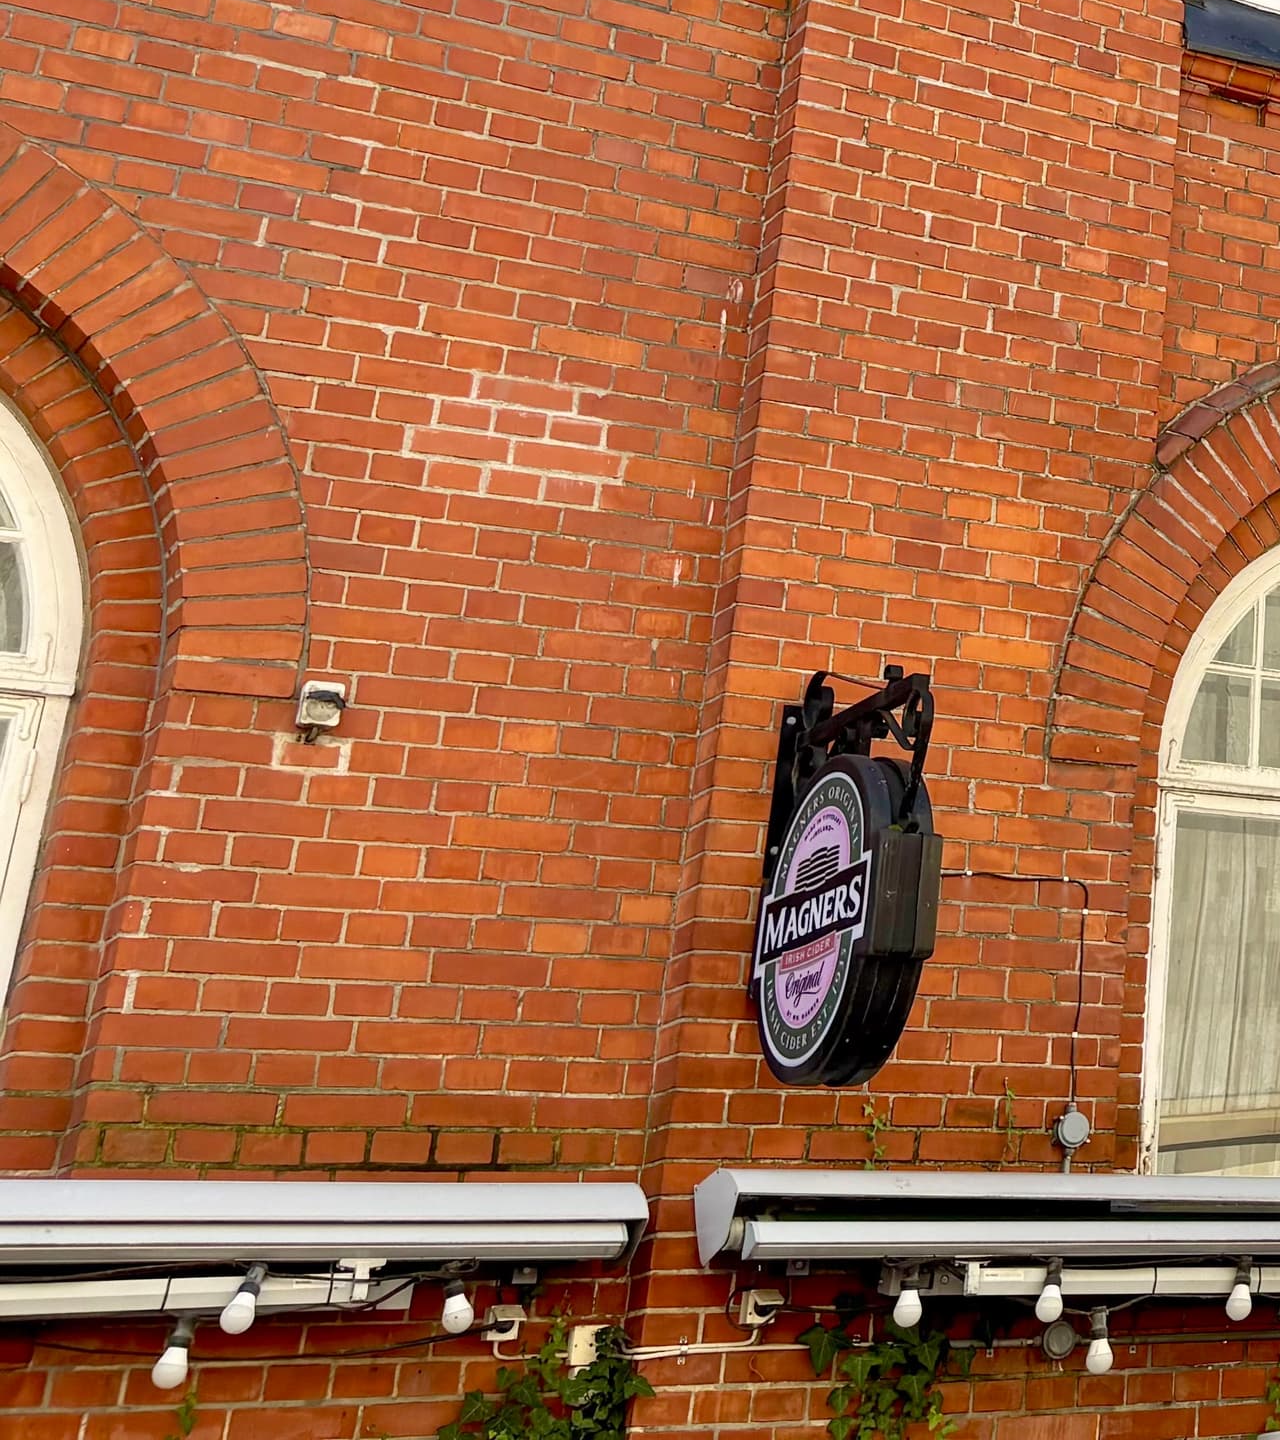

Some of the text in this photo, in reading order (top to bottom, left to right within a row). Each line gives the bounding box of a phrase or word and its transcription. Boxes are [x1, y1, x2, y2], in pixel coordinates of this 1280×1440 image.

[763, 874, 863, 954] MAGNERS
[784, 938, 832, 965] IRISH CIDER
[785, 961, 825, 1008] Original
[780, 1031, 808, 1050] CIDER
